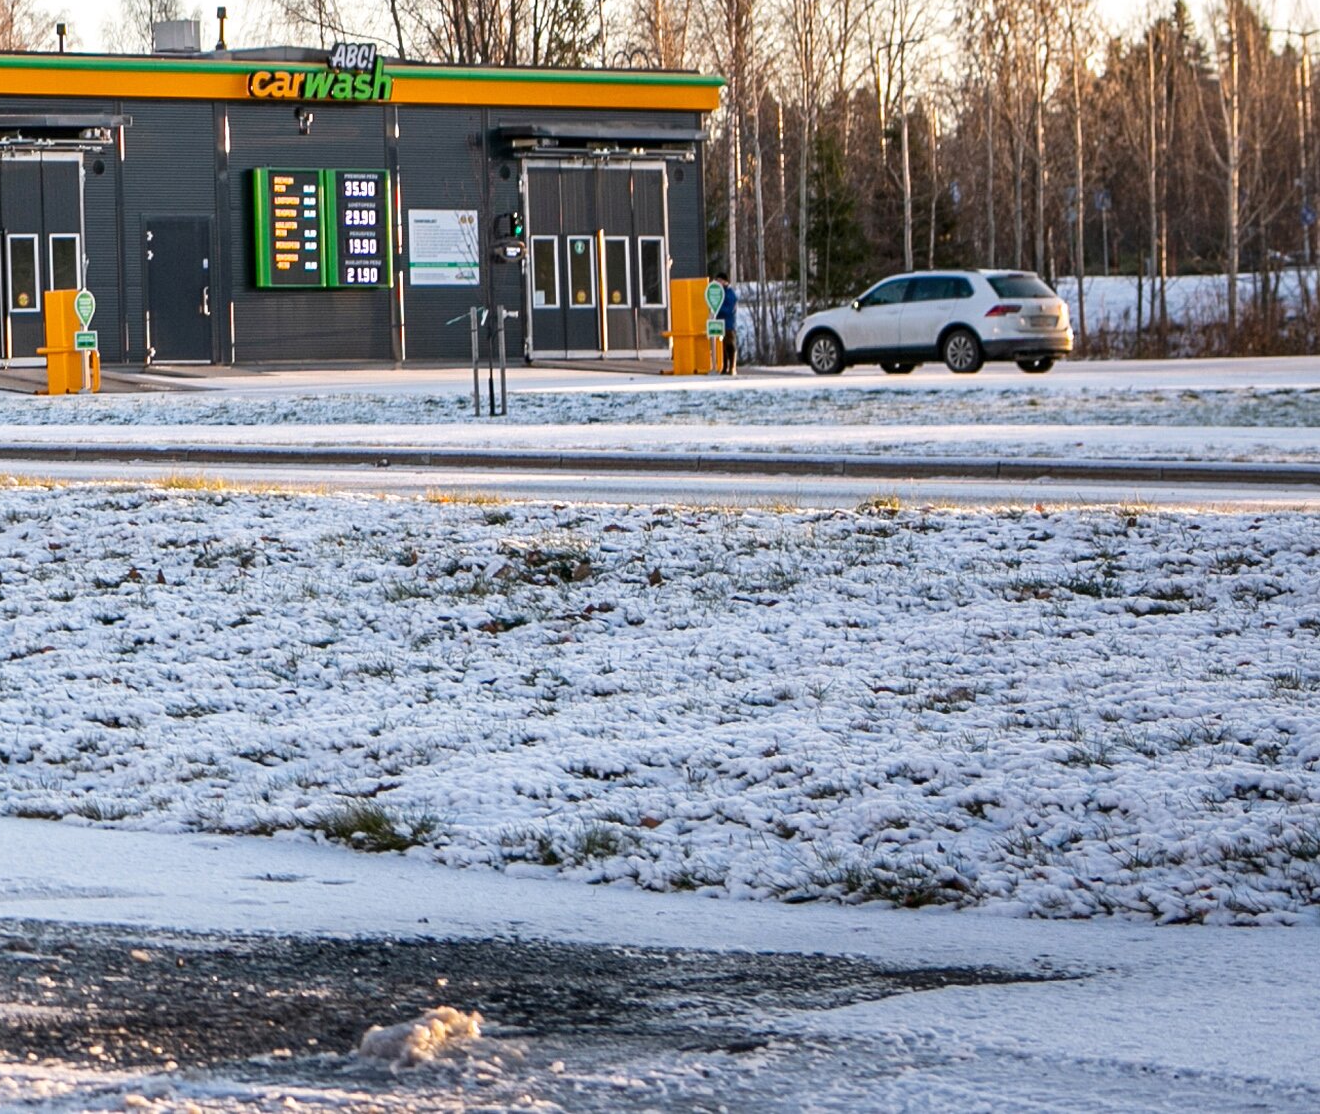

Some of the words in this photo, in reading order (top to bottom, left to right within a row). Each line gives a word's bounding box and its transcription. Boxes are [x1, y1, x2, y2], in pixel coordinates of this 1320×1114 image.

[332, 44, 375, 69] ABC!
[251, 55, 392, 101] carwash
[344, 181, 376, 197] 35.90
[345, 209, 376, 225] 29.90
[349, 239, 377, 254] 19.90
[346, 267, 378, 283] 21.90
